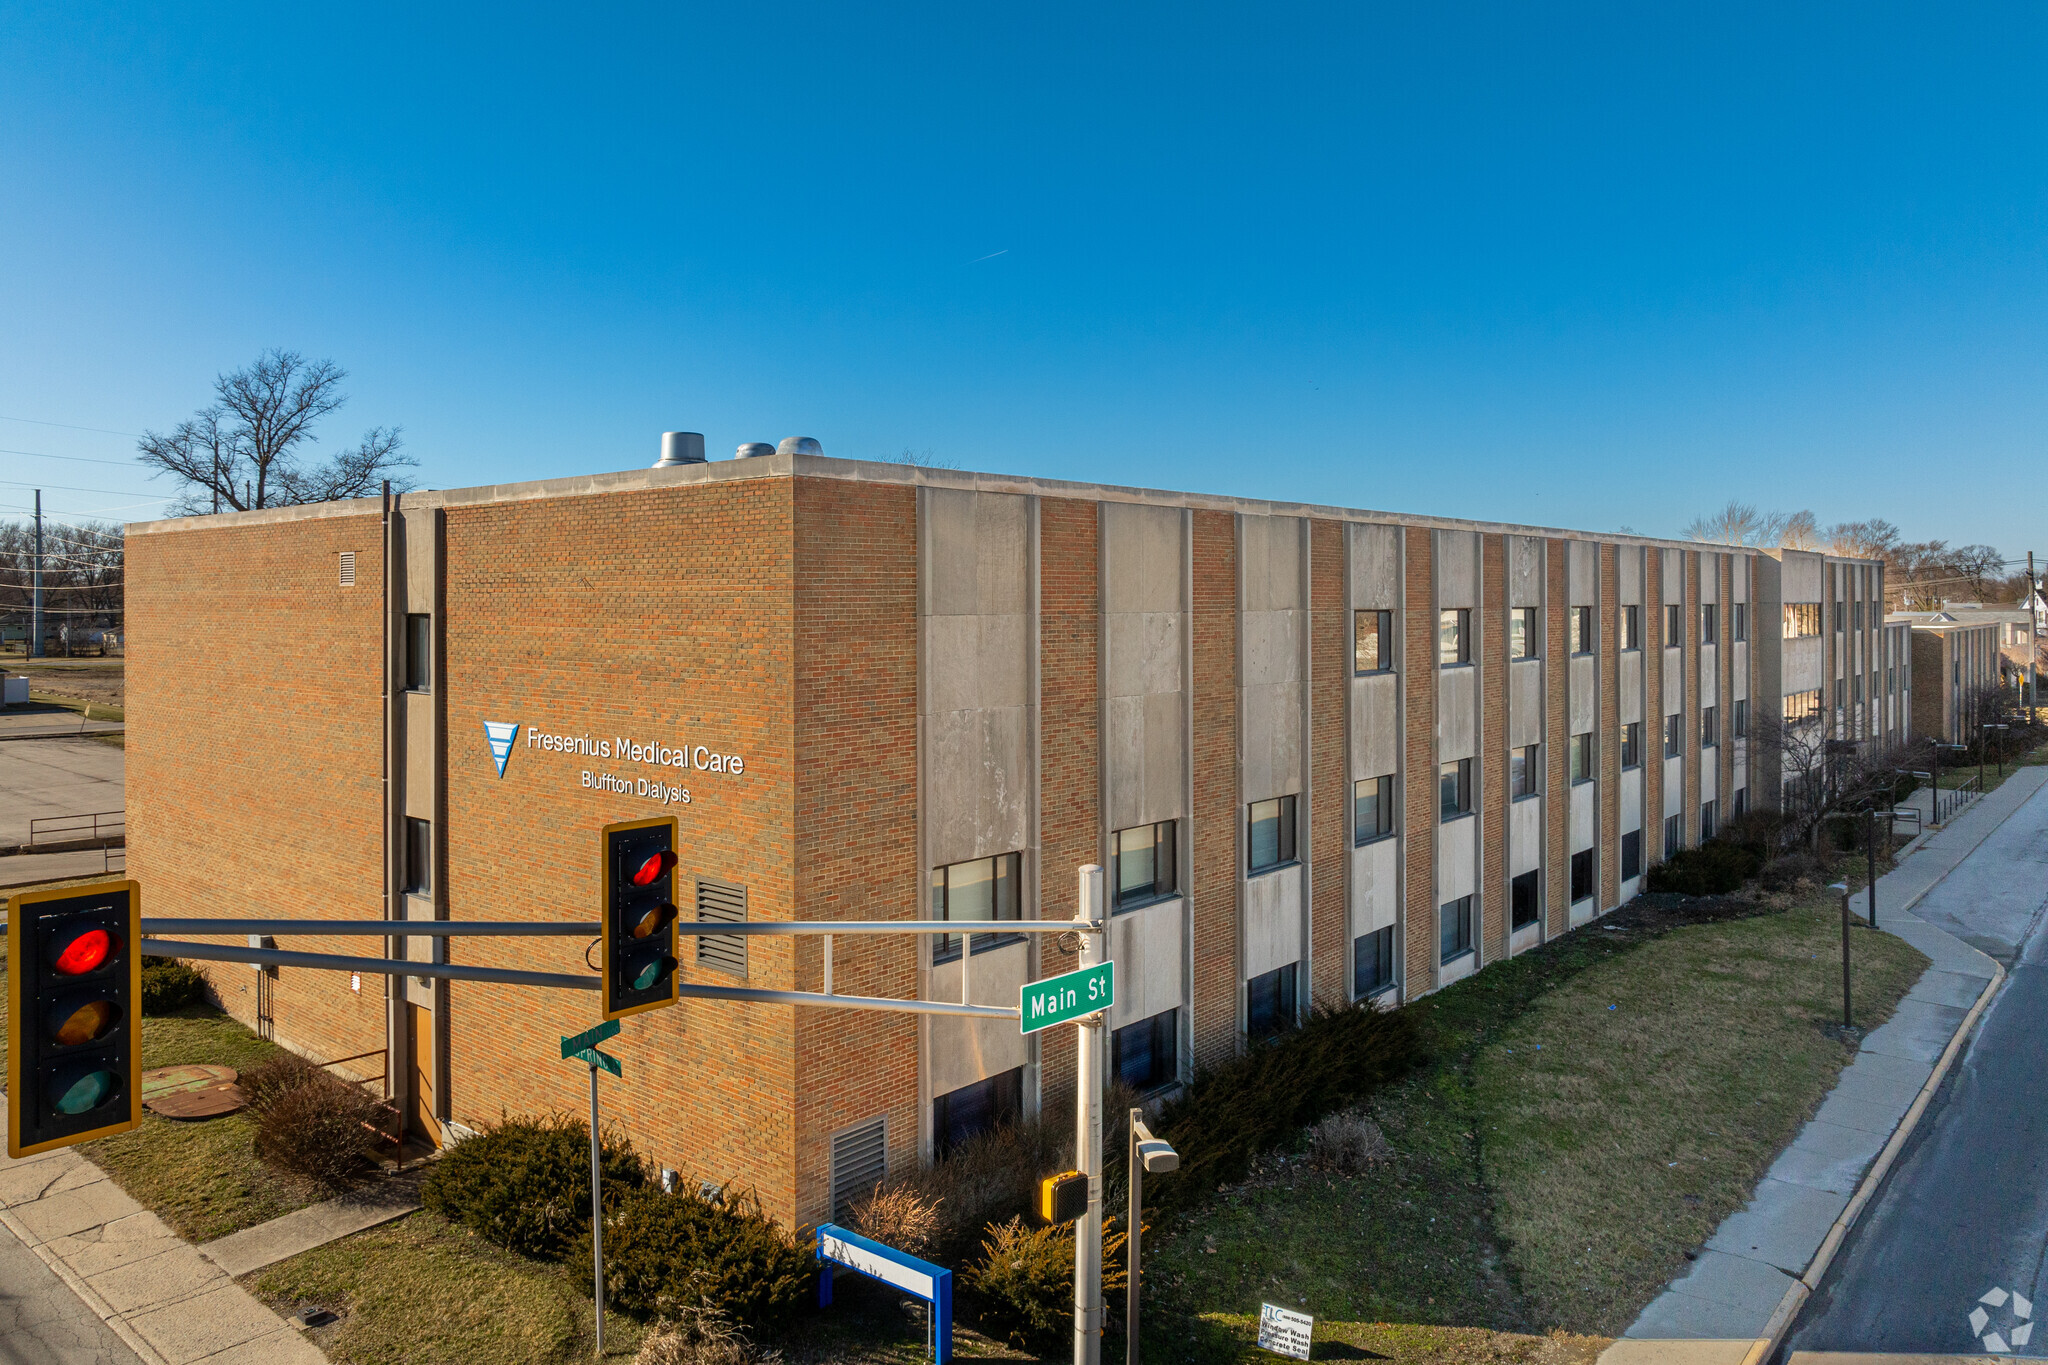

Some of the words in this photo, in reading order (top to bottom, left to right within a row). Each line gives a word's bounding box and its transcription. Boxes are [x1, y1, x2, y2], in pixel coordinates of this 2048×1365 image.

[527, 727, 611, 758] Fresenius
[615, 737, 689, 768] Medical
[693, 745, 744, 774] Care
[581, 770, 634, 795] Bluffton
[637, 778, 691, 804] Dialysis
[1031, 987, 1076, 1019] Main
[1088, 975, 1106, 1001] St
[572, 1027, 603, 1052] MAIN
[1263, 1304, 1284, 1322] TLC
[1260, 1328, 1289, 1342] Pressure
[1290, 1337, 1309, 1348] Wash
[1261, 1320, 1289, 1334] Window
[1290, 1329, 1310, 1340] Wash
[1260, 1335, 1290, 1350] Concrete
[1292, 1345, 1308, 1355] Seal
